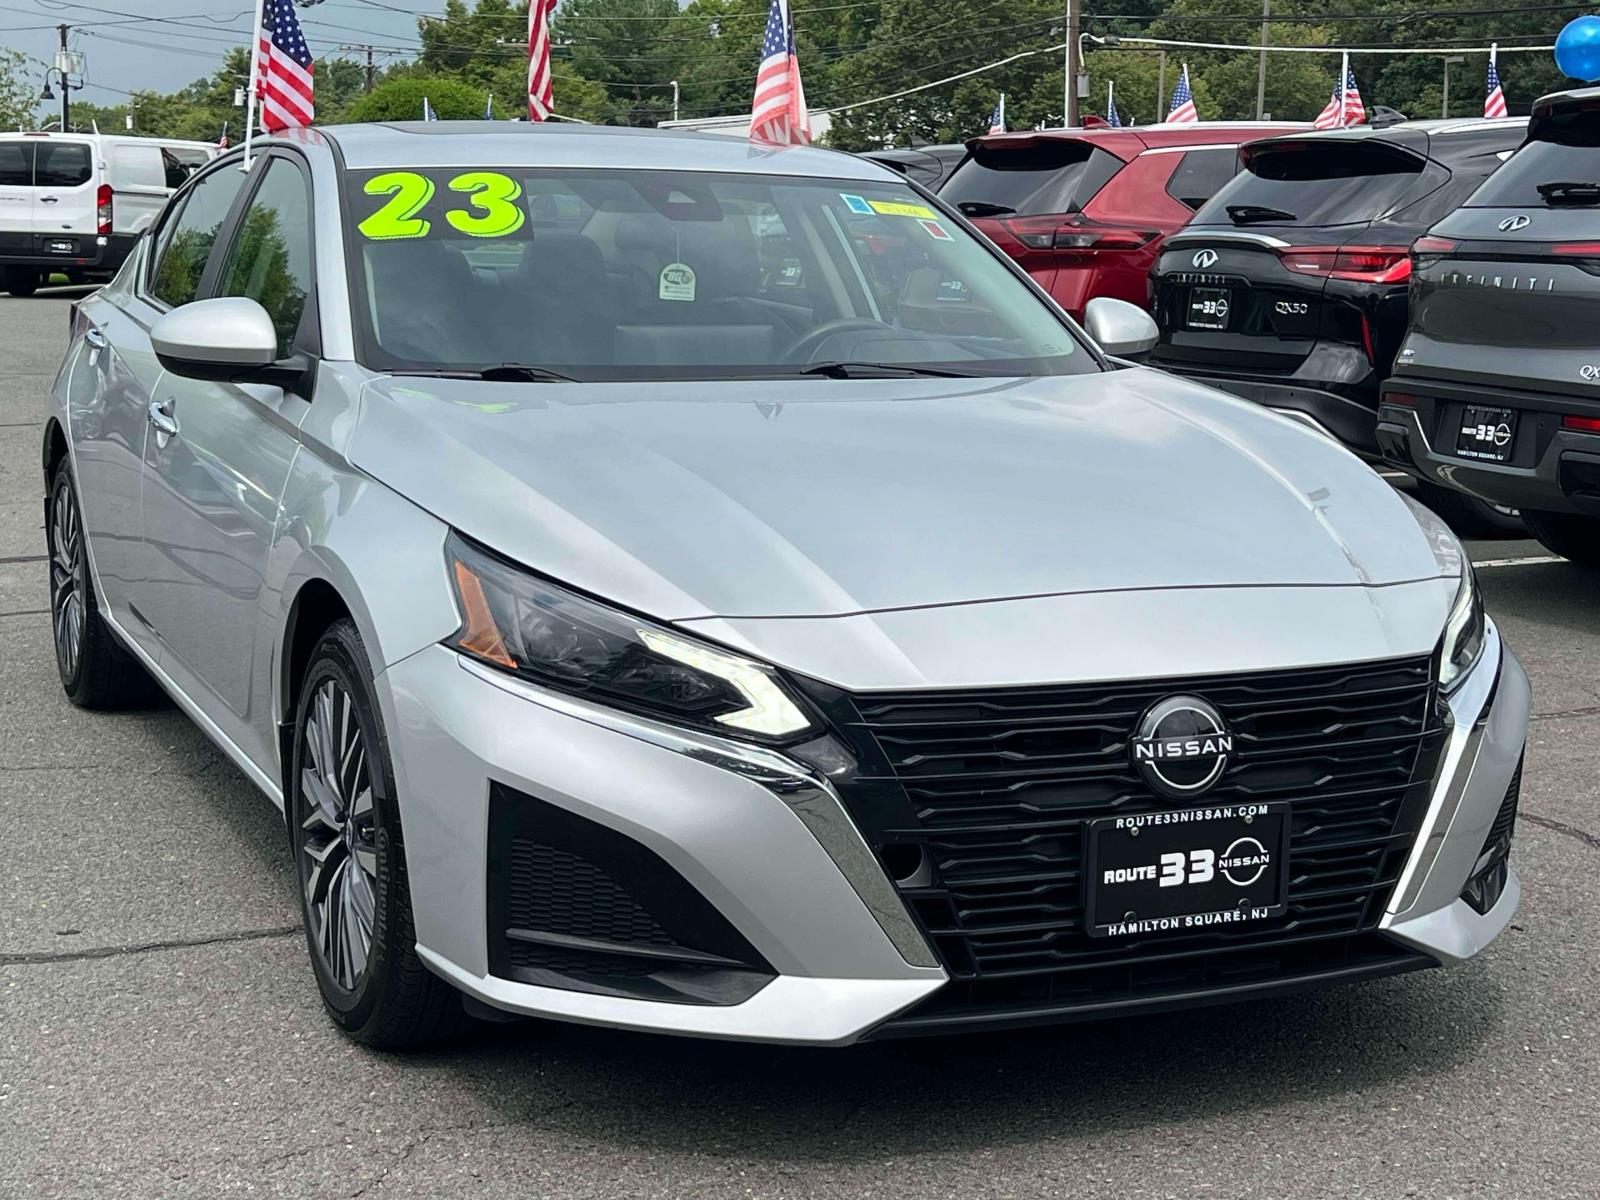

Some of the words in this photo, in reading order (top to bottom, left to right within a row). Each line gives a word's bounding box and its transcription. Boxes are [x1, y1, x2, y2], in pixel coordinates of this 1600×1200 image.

[358, 171, 526, 240] 23
[1203, 301, 1216, 313] 33
[1476, 424, 1496, 441] 33
[1136, 736, 1232, 758] NISSAN
[1116, 805, 1267, 828] ROUTE33NISSAN.COM
[1104, 866, 1156, 884] ROUTE
[1159, 849, 1215, 887] 33
[1218, 854, 1270, 868] NISSAN
[1108, 918, 1179, 936] HAMILTON
[1251, 908, 1268, 919] NJ
